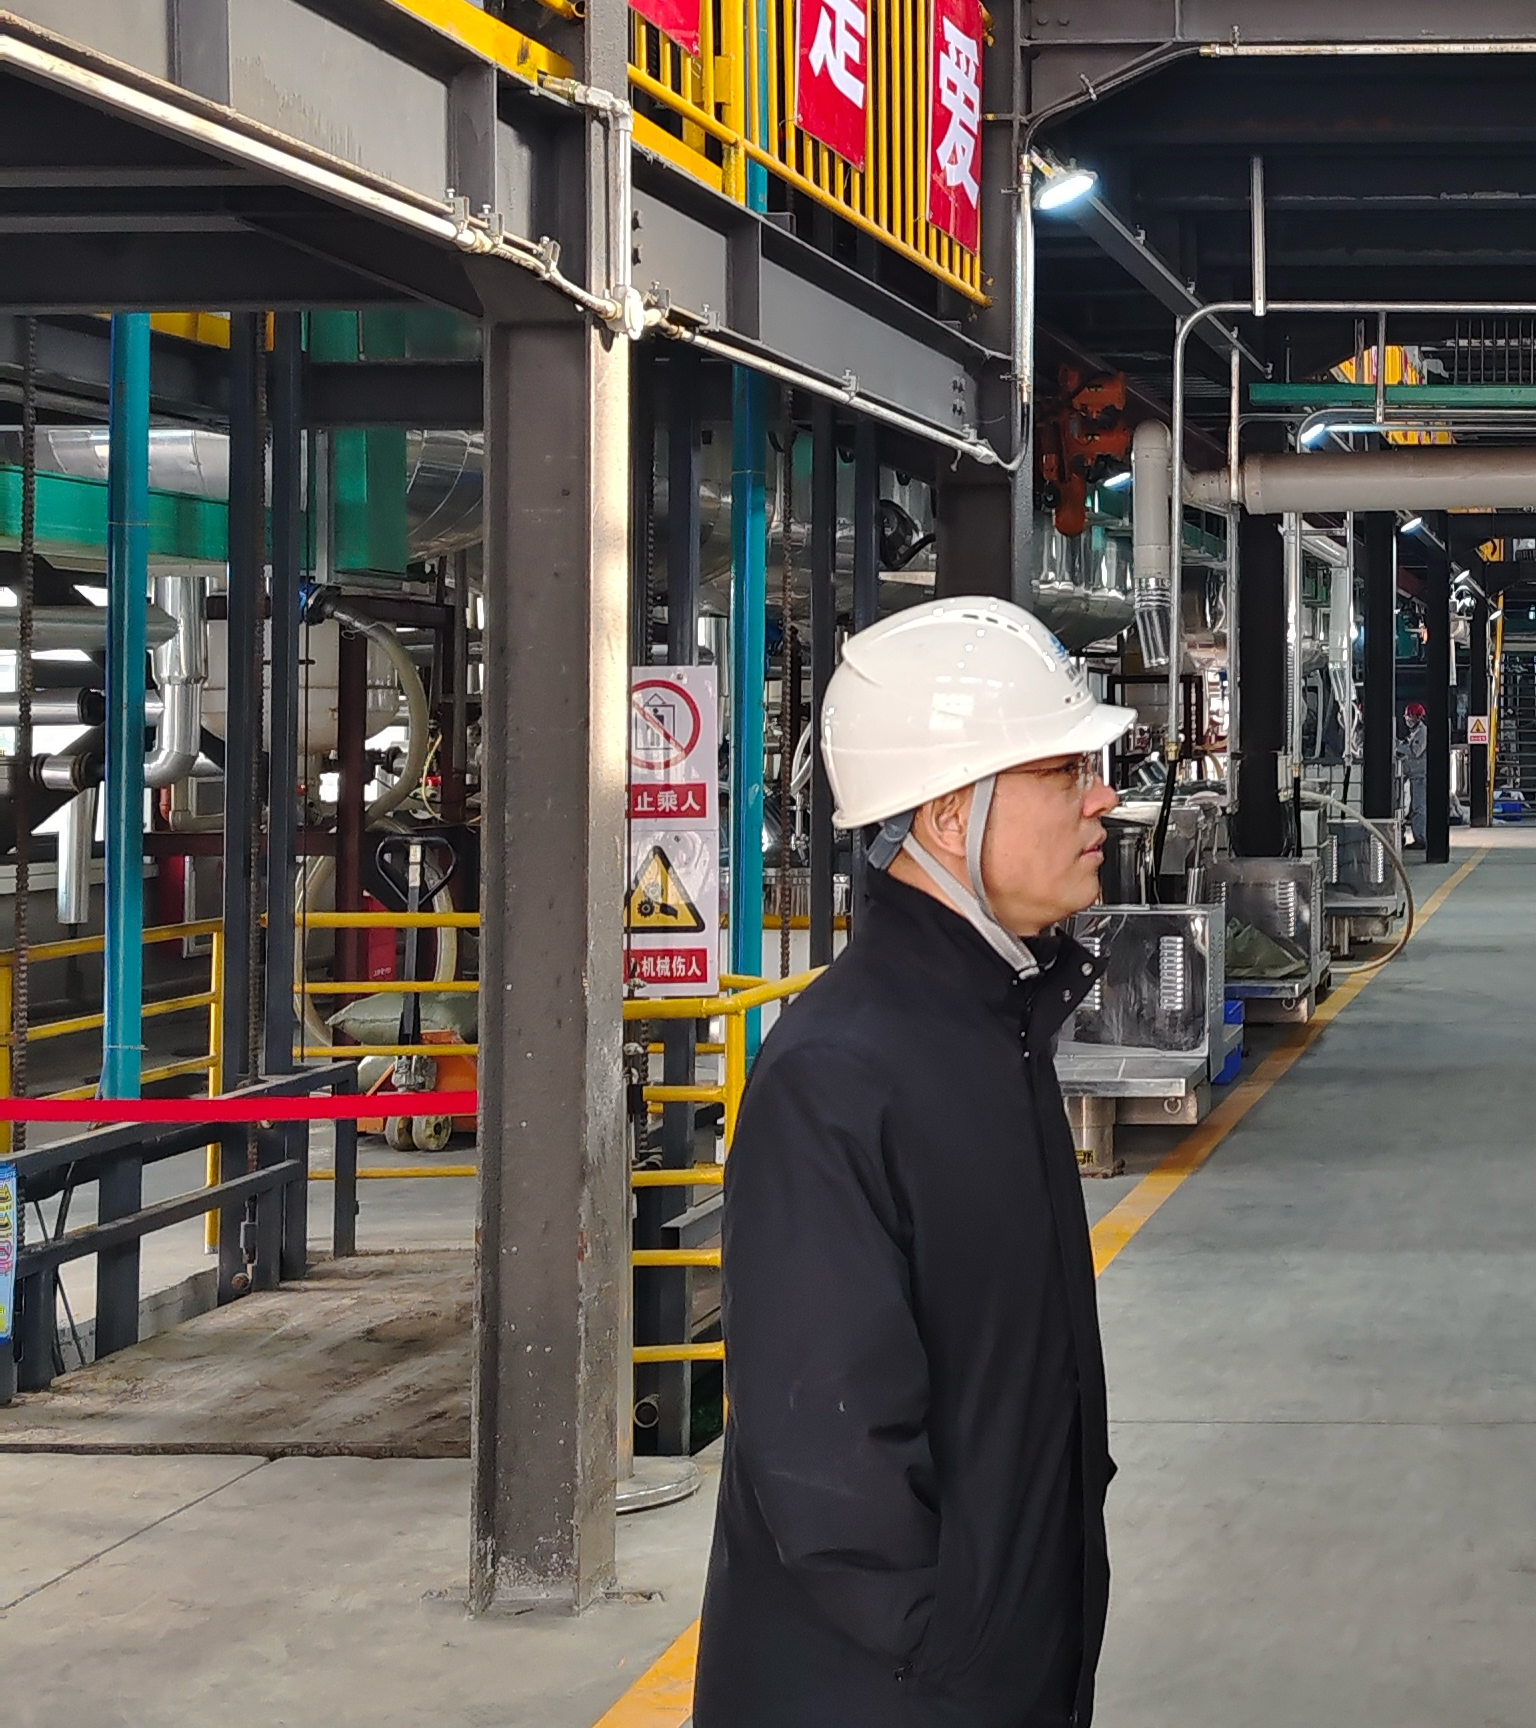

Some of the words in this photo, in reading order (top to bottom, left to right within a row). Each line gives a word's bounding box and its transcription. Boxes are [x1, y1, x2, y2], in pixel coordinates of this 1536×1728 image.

[936, 15, 980, 210] 爱
[625, 790, 701, 812] 止乘人
